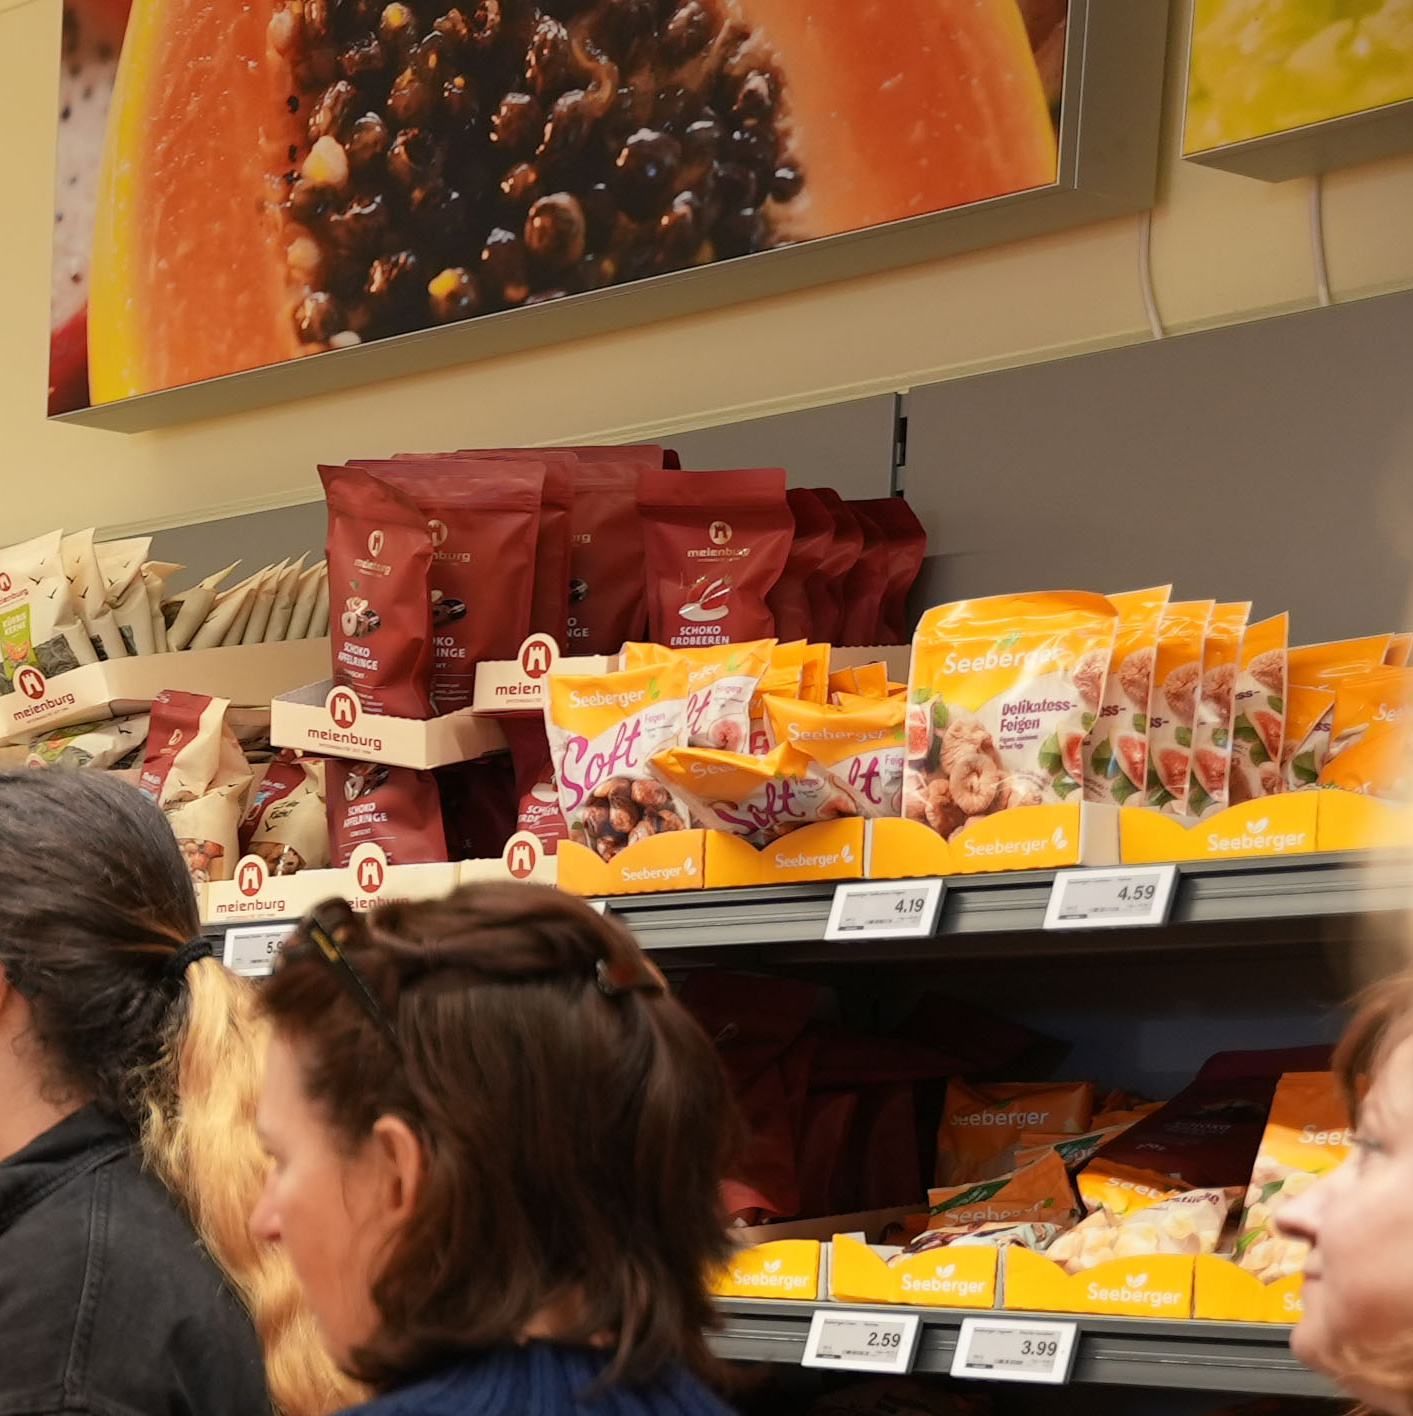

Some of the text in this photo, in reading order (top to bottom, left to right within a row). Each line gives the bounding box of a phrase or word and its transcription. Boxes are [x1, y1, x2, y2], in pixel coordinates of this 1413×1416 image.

[431, 549, 471, 563] nburg
[679, 625, 722, 636] SCHOKO
[343, 641, 371, 657] SCHOKO
[670, 636, 730, 646] ERDBEEREN
[941, 647, 1065, 675] Seeberger
[495, 682, 541, 696] meien
[13, 692, 75, 722] meienburg
[569, 688, 645, 709] Seeberger
[1002, 698, 1078, 717] Delikatess-
[788, 722, 887, 742] Seeberger
[1000, 716, 1041, 734] Feigen
[307, 728, 382, 751] meienburg
[561, 719, 642, 812] Soft
[347, 802, 376, 816] SCHOKO
[964, 838, 1048, 858] Seeberger
[1207, 830, 1306, 853] Seeberger
[775, 852, 840, 869] Seeberger
[621, 866, 683, 882] Seeberger
[1117, 884, 1155, 900] 4.59
[216, 899, 286, 915] meienburg
[346, 896, 410, 911] eienburg
[895, 898, 925, 913] 4.19
[266, 940, 284, 955] 5.9
[733, 1270, 810, 1291] Seeberger
[901, 1274, 986, 1297] Seeberger
[1087, 1282, 1182, 1308] Seeberger
[867, 1332, 901, 1348] 2.59
[1021, 1340, 1058, 1357] 3.99
